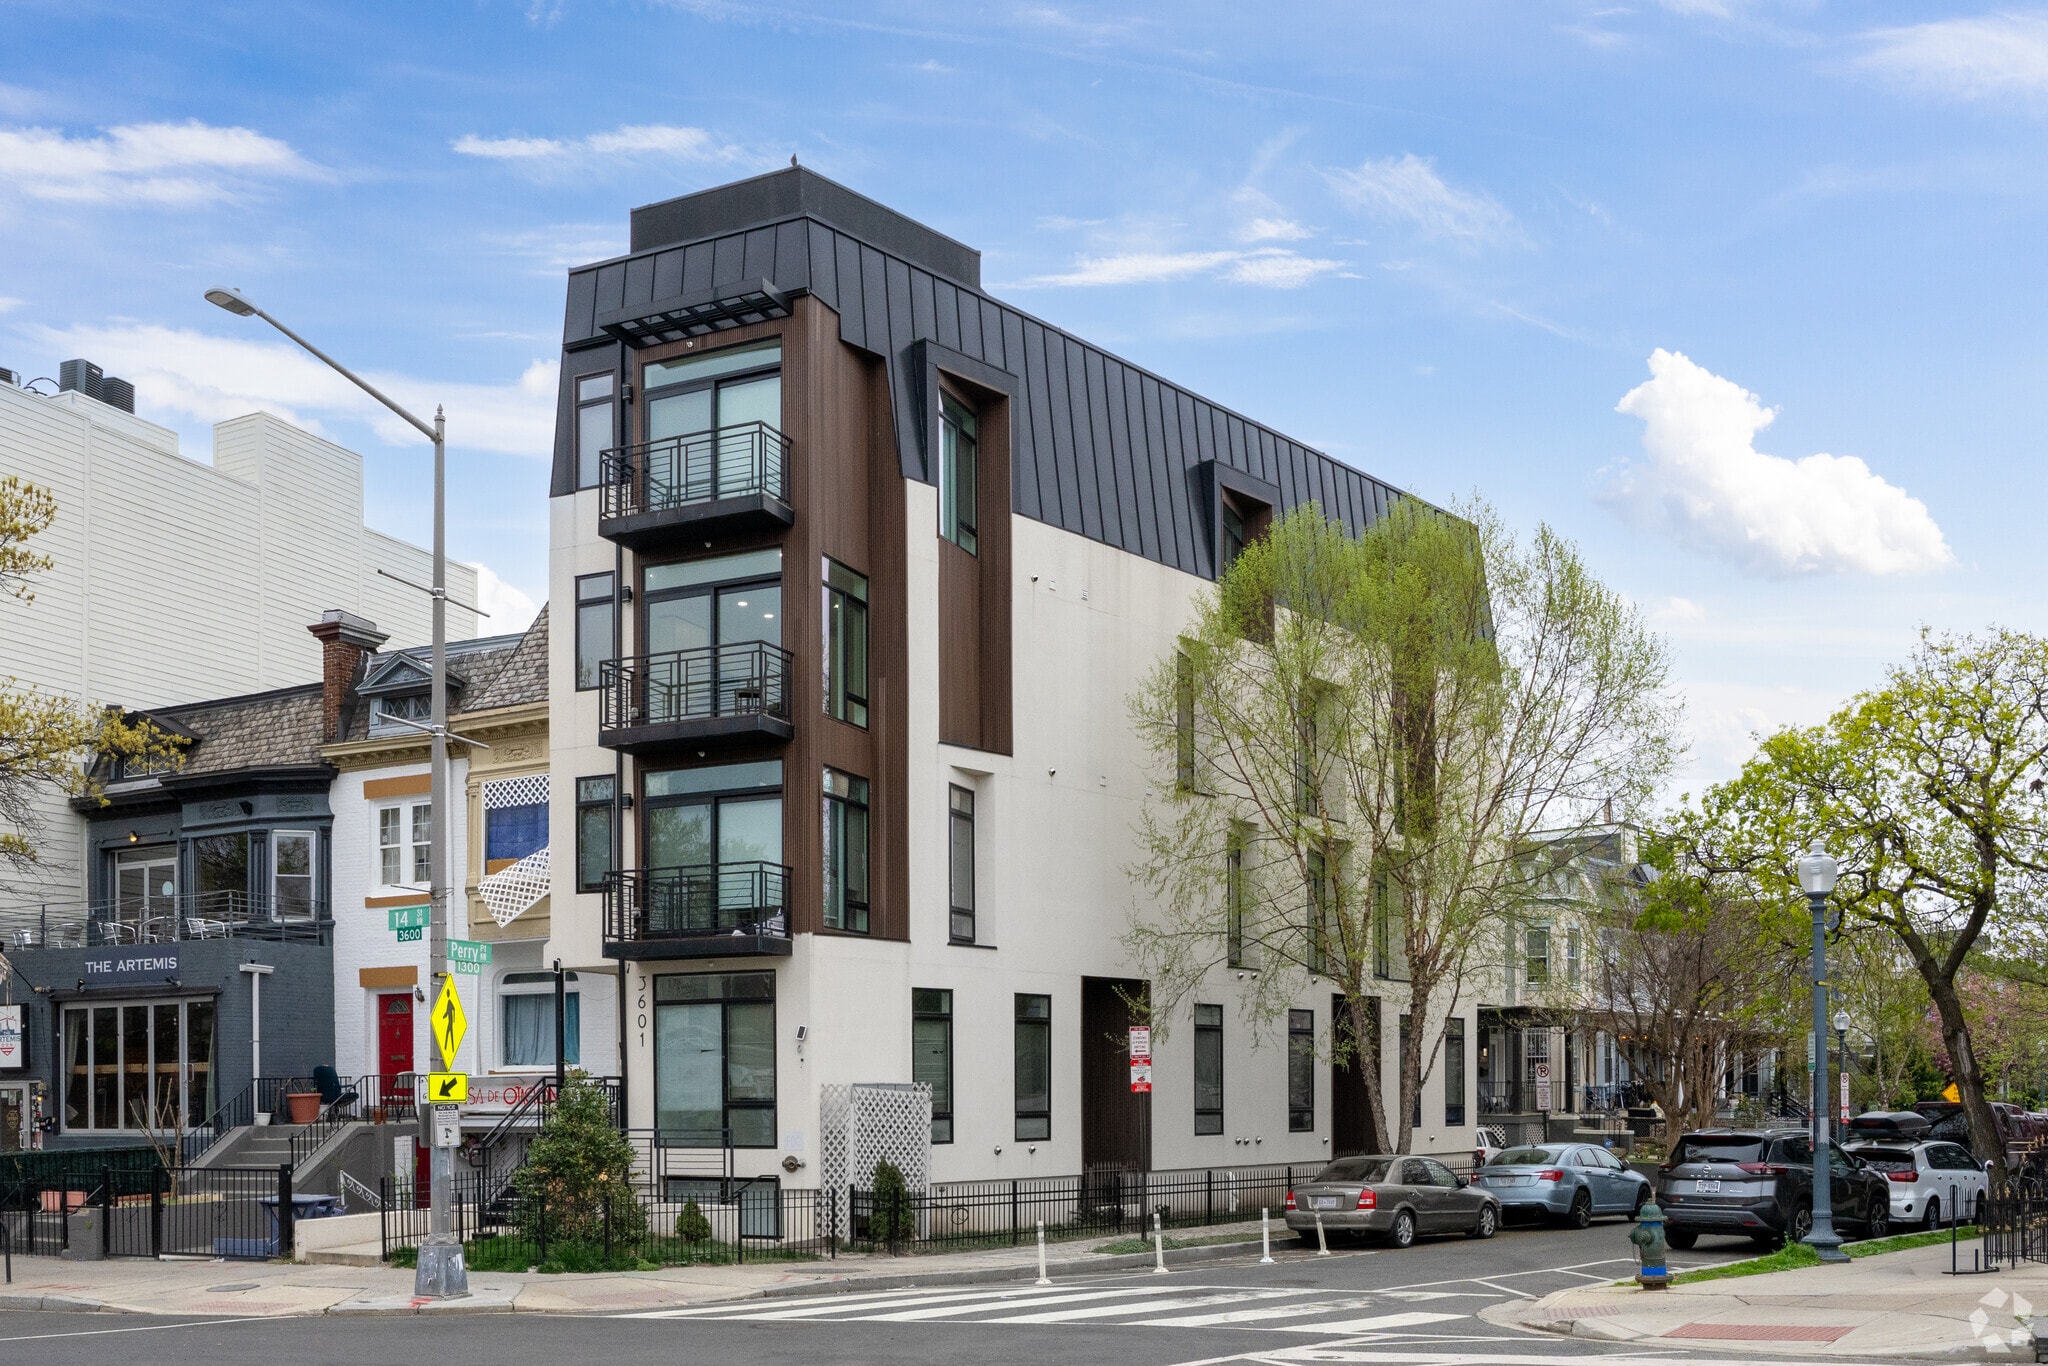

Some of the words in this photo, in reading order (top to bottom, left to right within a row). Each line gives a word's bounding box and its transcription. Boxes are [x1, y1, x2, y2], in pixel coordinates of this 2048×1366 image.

[394, 911, 409, 927] 14
[398, 929, 421, 941] 3600
[451, 942, 478, 962] Perry
[85, 960, 112, 974] THE
[116, 957, 177, 972] ARTEMIS
[457, 961, 480, 973] 1300
[638, 975, 647, 1047] 3601
[0, 1034, 21, 1042] RTEMIS
[462, 1086, 484, 1105] SA
[487, 1090, 500, 1102] DE
